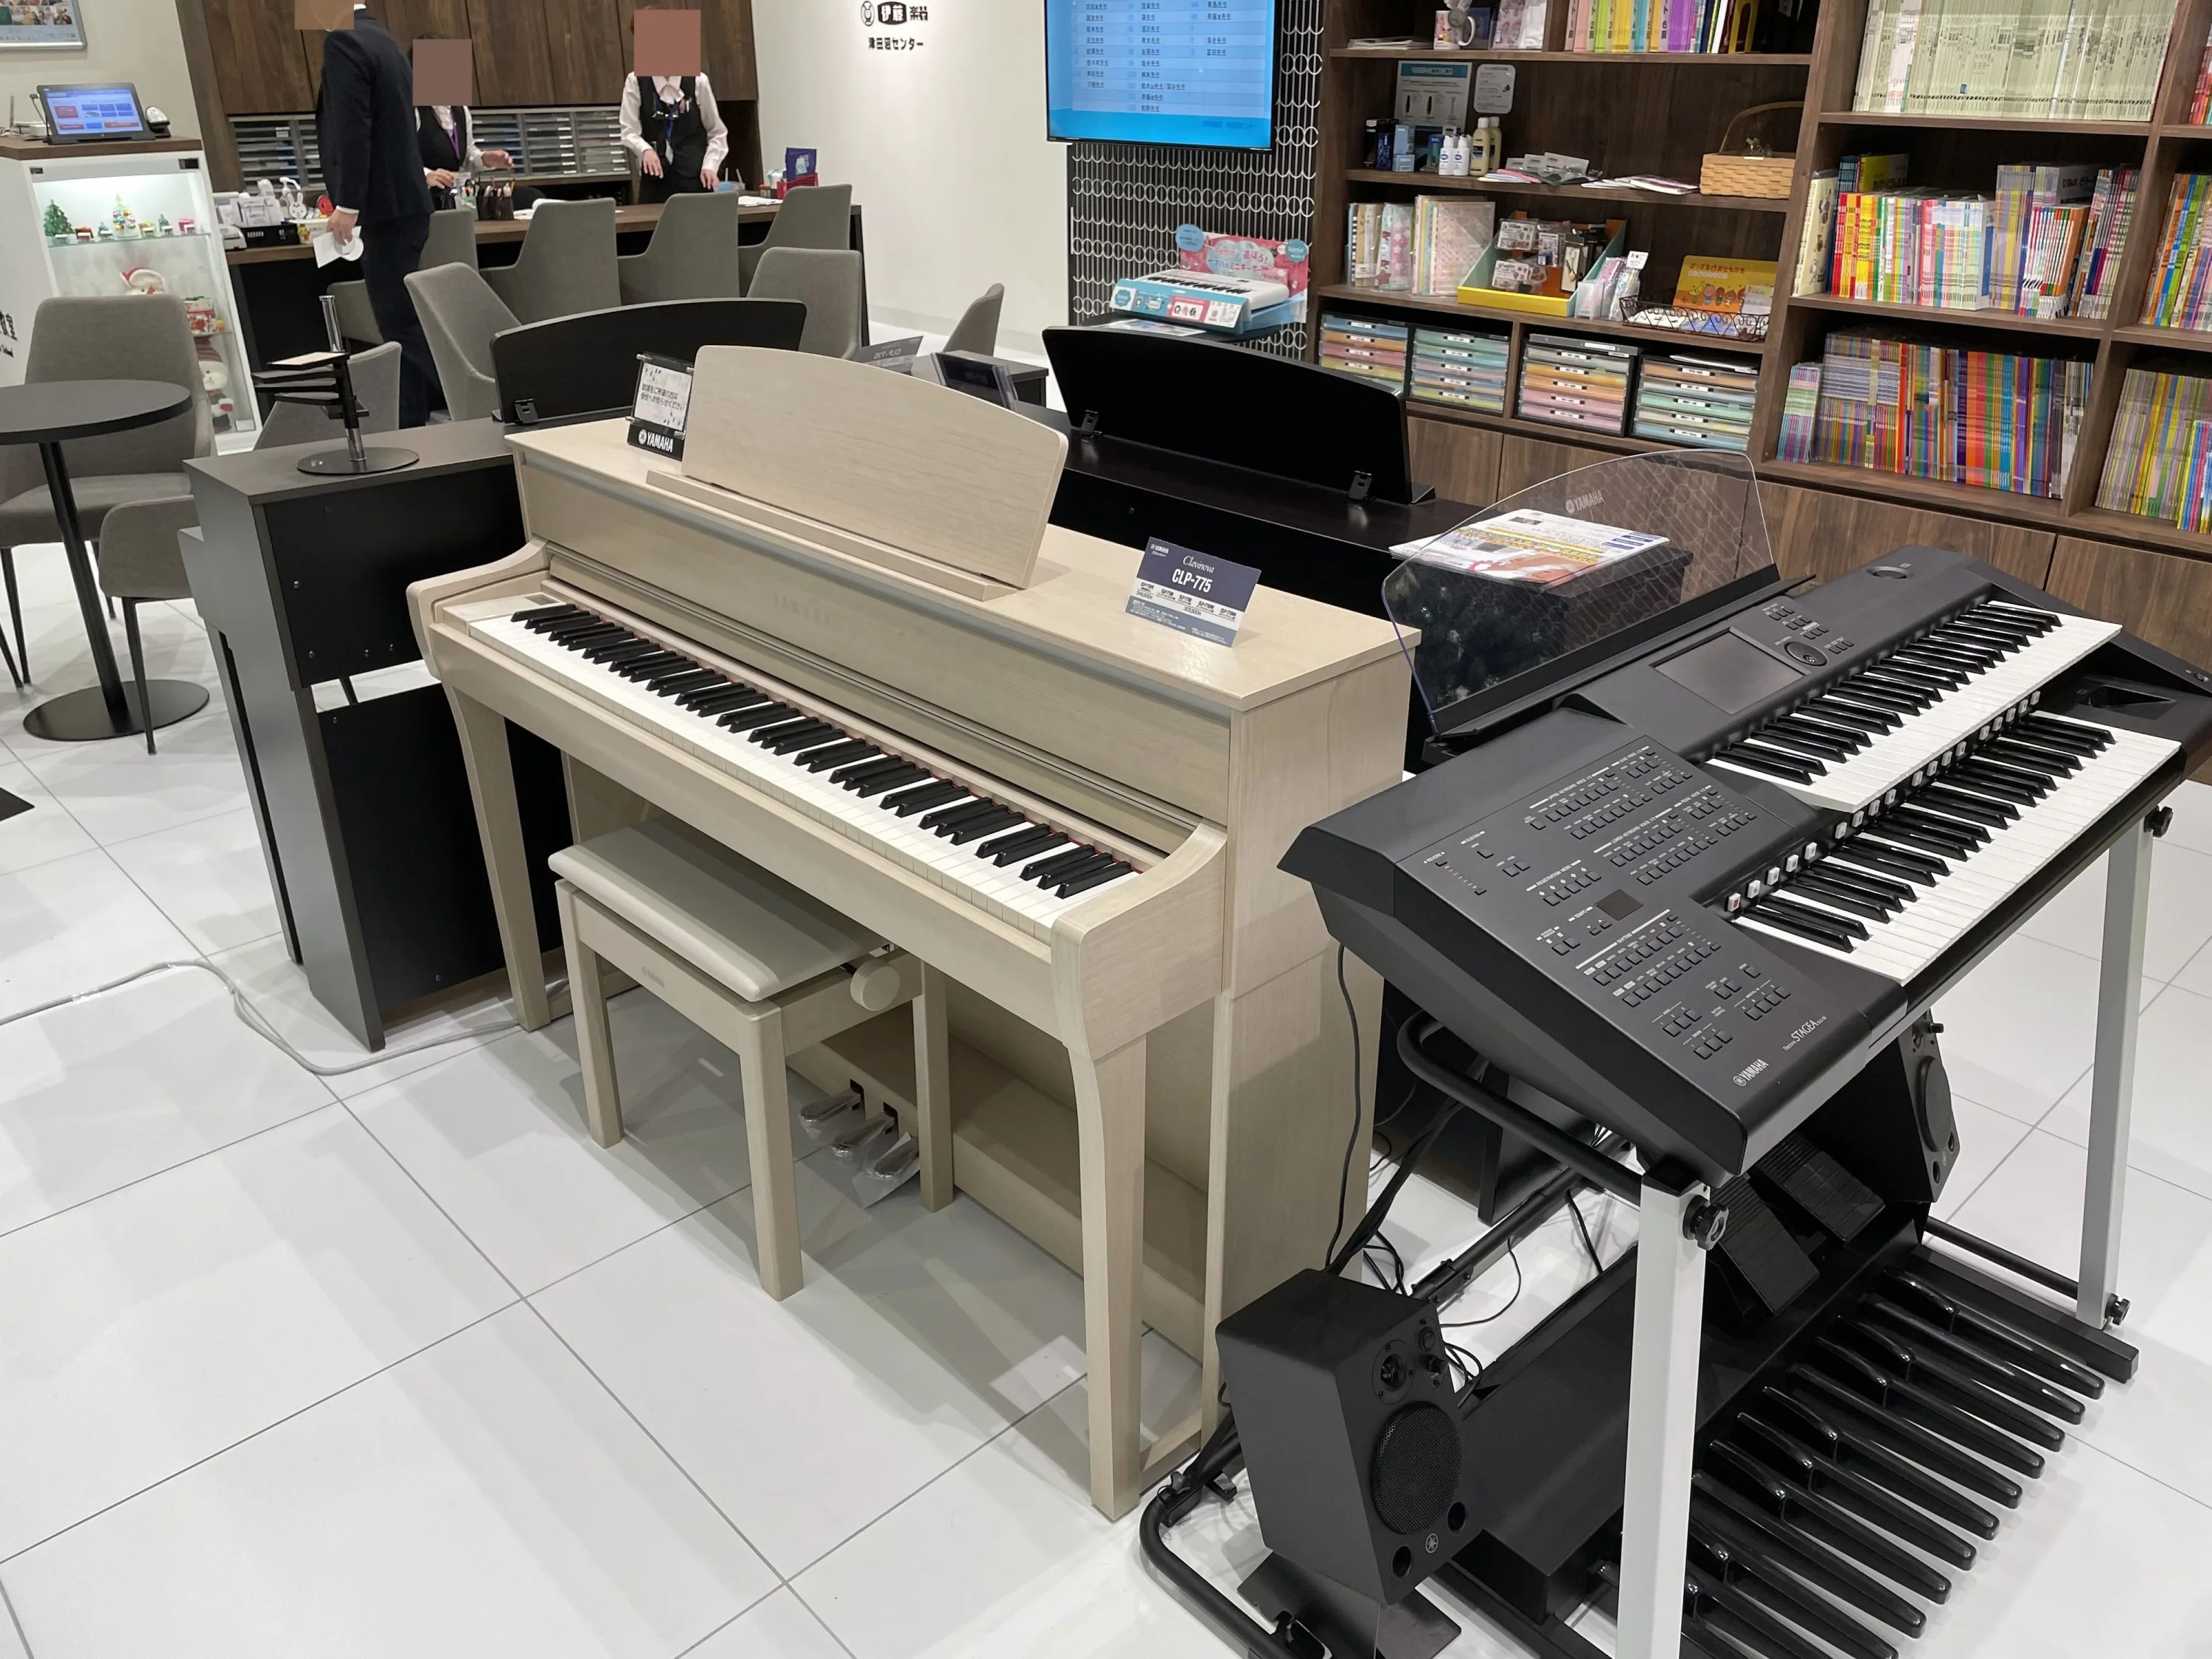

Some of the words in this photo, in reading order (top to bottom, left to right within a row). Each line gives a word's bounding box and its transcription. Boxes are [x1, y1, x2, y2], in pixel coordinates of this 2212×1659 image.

[868, 37, 924, 50] 津田沼センター
[647, 431, 673, 453] YAMAHA
[1573, 490, 1604, 511] YAMAHA
[1183, 555, 1215, 574] Clavinova
[1172, 568, 1213, 593] CLP-775
[1791, 1020, 1819, 1042] STAGEA
[1739, 1059, 1769, 1081] YAMAHA
